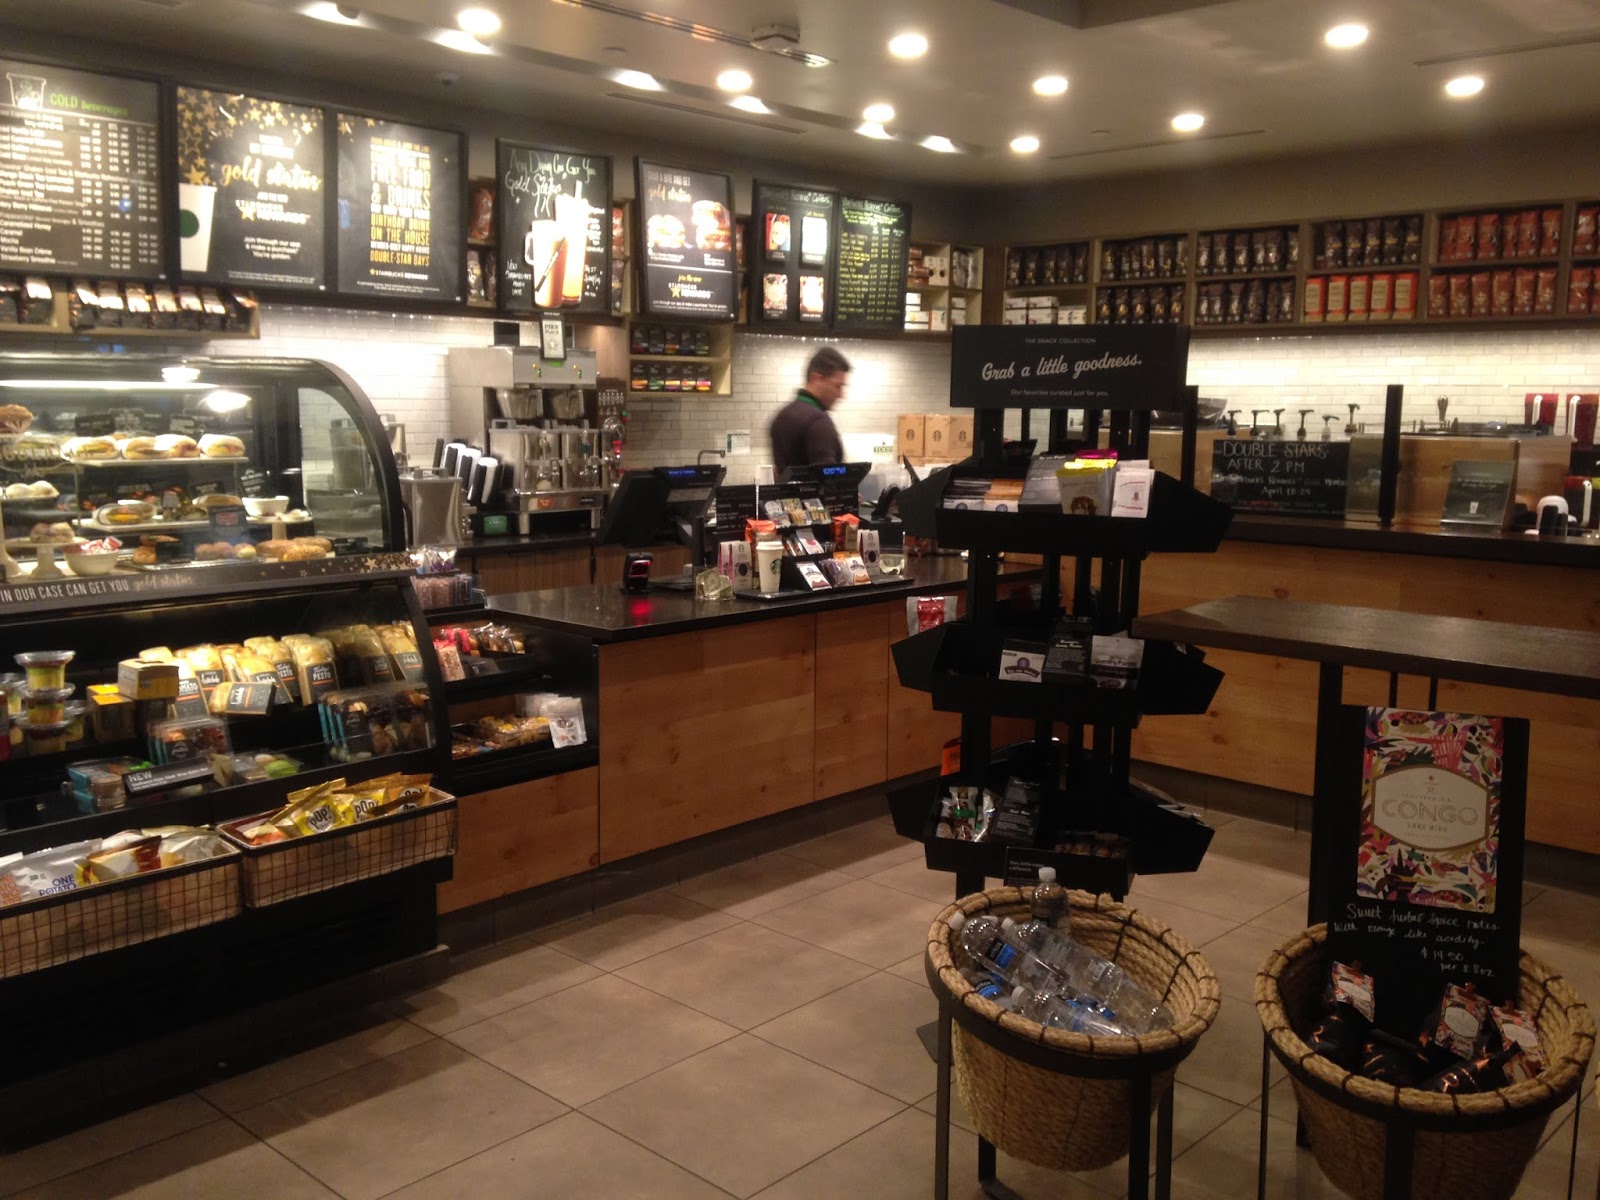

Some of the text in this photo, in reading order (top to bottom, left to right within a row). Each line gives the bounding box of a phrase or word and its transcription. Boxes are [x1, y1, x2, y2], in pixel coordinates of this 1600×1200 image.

[50, 94, 78, 109] COLD
[221, 156, 321, 190] gold status
[505, 171, 530, 197] Gold
[649, 184, 666, 201] gold
[371, 214, 405, 229] BIRTHDAY
[371, 226, 430, 246] ON THE HOUSE
[982, 352, 1143, 382] Grab a little goodness.
[1223, 441, 1328, 459] DOUBLE STARS
[1227, 458, 1265, 472] AFTER
[1270, 460, 1281, 473] 2
[1261, 486, 1283, 499] April
[15, 588, 37, 601] OUR
[38, 585, 64, 599] CASE
[66, 583, 87, 597] CAN
[88, 581, 107, 594] GET
[110, 580, 130, 593] YOU
[134, 578, 158, 593] gold
[312, 672, 332, 682] PESTO
[128, 770, 153, 783] NEW
[310, 806, 332, 830] POP!
[1382, 799, 1479, 826] CONGO
[52, 874, 75, 887] ONE
[39, 882, 77, 897] POTATO
[1347, 904, 1382, 921] Sweet
[1440, 963, 1459, 973] per
